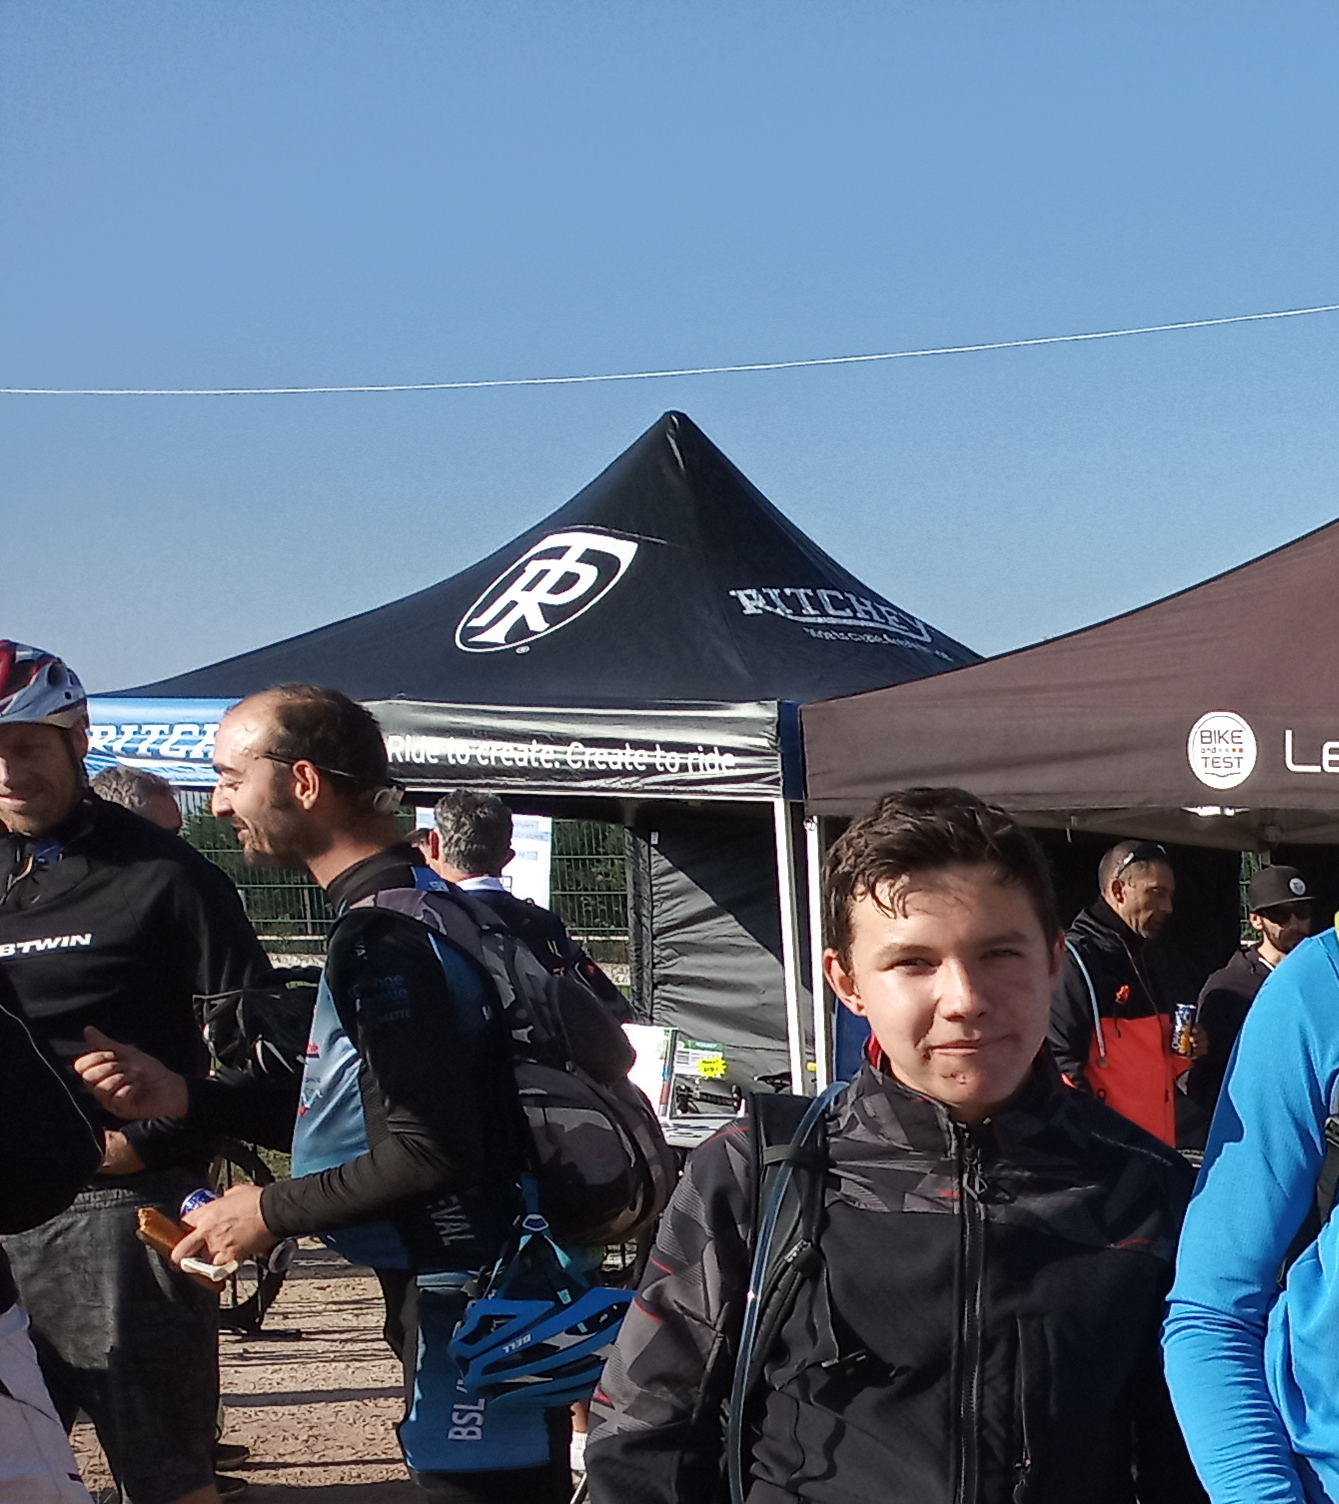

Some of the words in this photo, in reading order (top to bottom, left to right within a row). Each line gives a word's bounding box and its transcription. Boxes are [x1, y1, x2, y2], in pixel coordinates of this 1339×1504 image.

[729, 588, 932, 643] RITCHEY
[88, 724, 219, 759] RITCH
[447, 737, 470, 765] to
[566, 741, 647, 771] Create
[655, 743, 680, 772] to
[1200, 730, 1243, 745] BIKE
[1201, 756, 1243, 769] TEST
